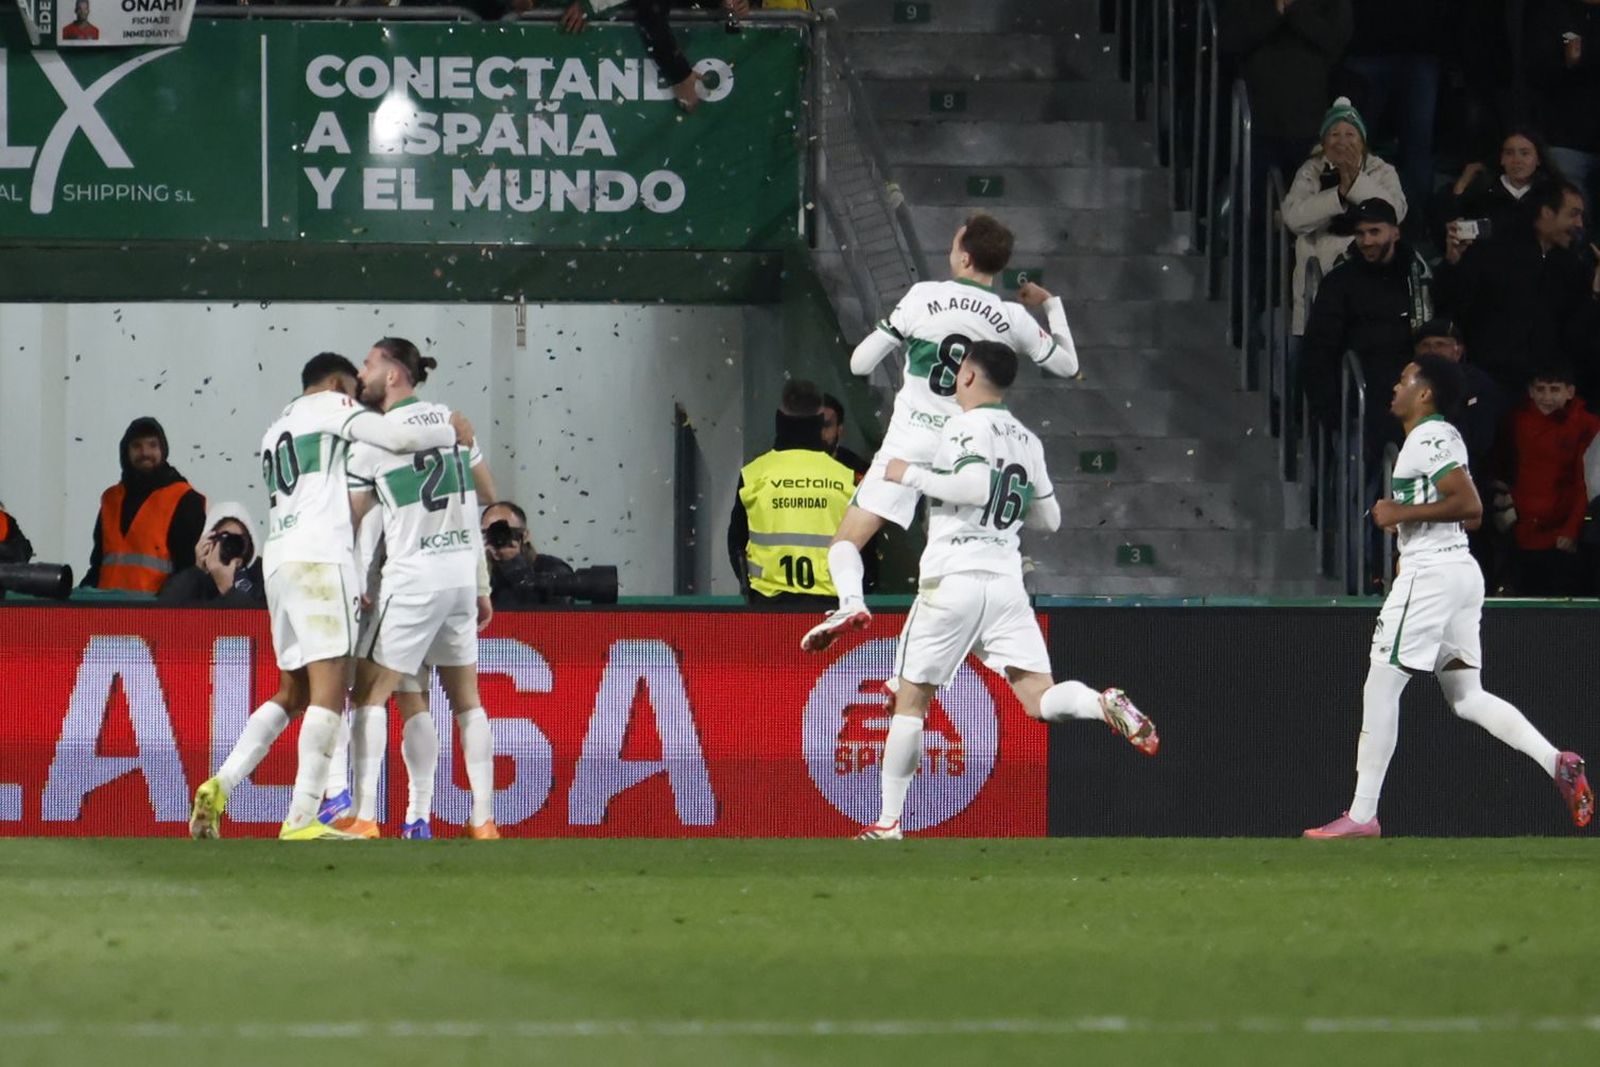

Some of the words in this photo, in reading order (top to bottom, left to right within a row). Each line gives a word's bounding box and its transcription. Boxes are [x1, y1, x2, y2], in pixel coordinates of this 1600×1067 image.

[132, 16, 170, 25] FICHAJE
[906, 5, 917, 20] 9
[943, 94, 954, 109] 8
[303, 111, 351, 154] A
[368, 101, 617, 156] ESPAÑA
[63, 184, 169, 201] SHIPPING
[303, 167, 347, 209] Y
[363, 167, 434, 210] EL
[451, 168, 686, 214] MUNDO
[979, 179, 990, 194] 7
[927, 297, 1010, 334] M.AGUADO
[929, 333, 972, 396] 8
[1092, 454, 1102, 470] 4
[413, 443, 466, 513] 21
[771, 478, 844, 491] vectalia
[979, 457, 1028, 530] 16
[772, 497, 828, 510] SEGURIDAD
[1130, 549, 1140, 562] 3
[779, 555, 815, 590] 10
[835, 746, 966, 777] SPTS
